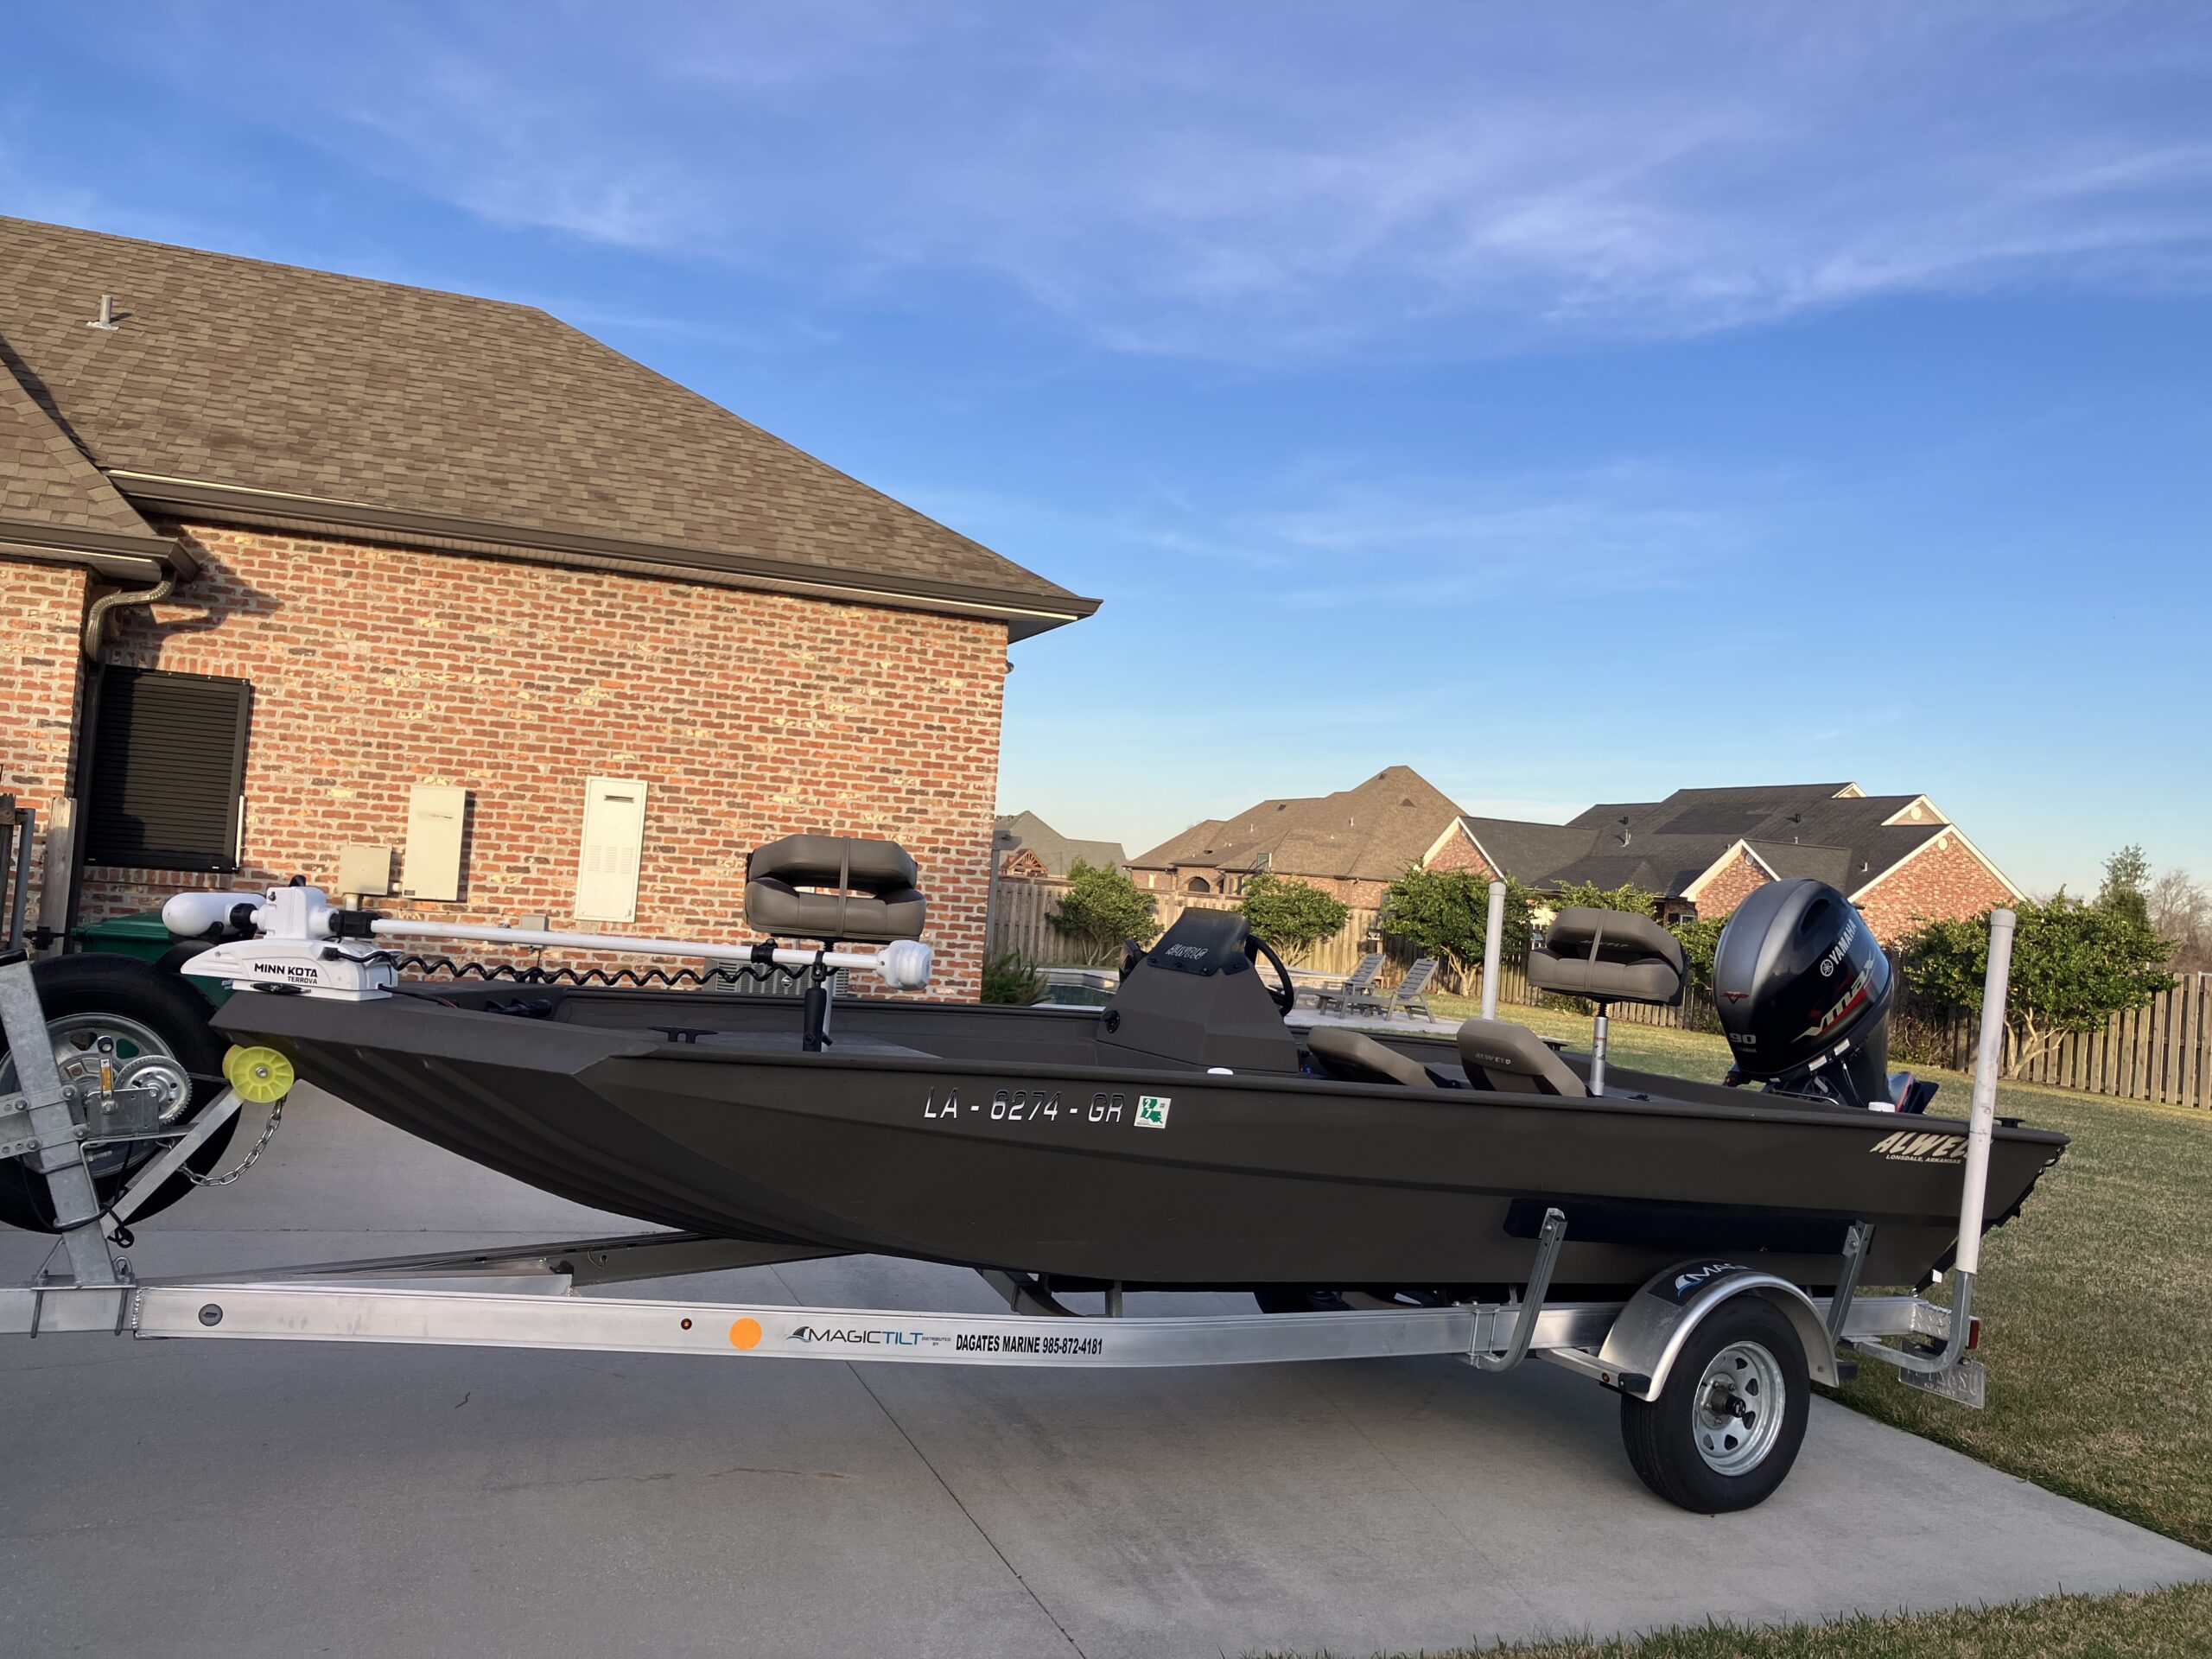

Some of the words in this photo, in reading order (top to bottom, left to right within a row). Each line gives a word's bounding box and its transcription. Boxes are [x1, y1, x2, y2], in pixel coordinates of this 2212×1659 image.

[1829, 918, 1857, 965] YAMAHA
[254, 963, 285, 975] MINN
[287, 966, 318, 977] KOTA
[287, 976, 318, 985] TERROVA
[1729, 1033, 1757, 1045] 90
[924, 1086, 958, 1119] LA
[990, 1089, 1061, 1122] 6274
[1089, 1092, 1125, 1122] GR
[1870, 1131, 1993, 1160] ALWEL
[809, 1328, 924, 1345] MAGICTILT
[956, 1334, 1001, 1352] DAGATES
[1002, 1336, 1040, 1353] MARINE
[1042, 1337, 1103, 1355] 985-872-4181
